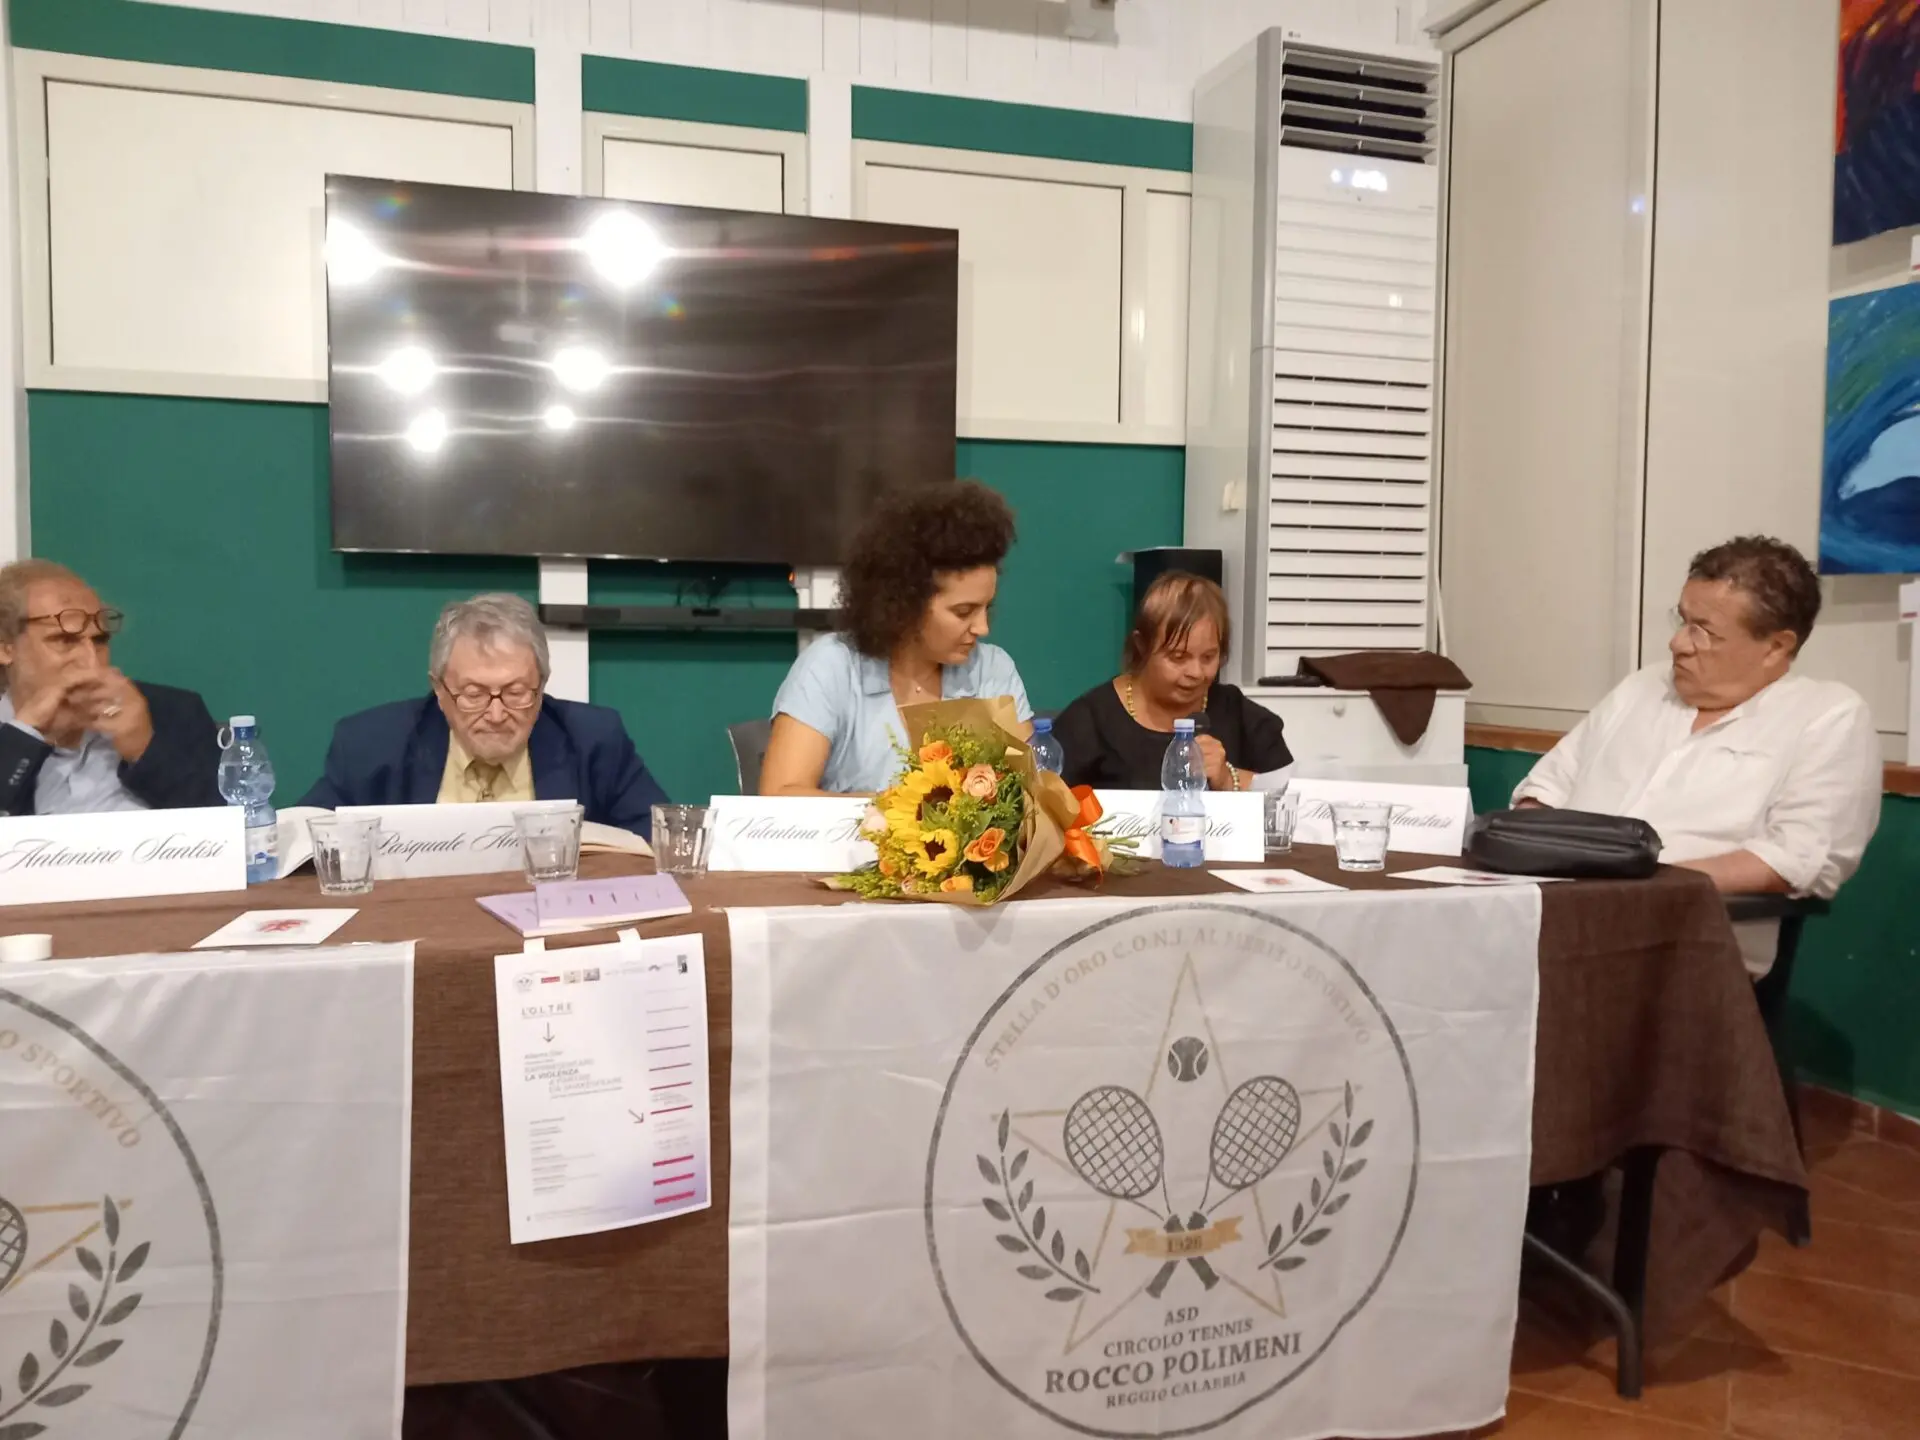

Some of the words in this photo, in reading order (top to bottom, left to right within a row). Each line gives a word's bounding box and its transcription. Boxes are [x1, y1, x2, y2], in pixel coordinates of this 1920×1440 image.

[379, 830, 466, 862] Pasquale
[726, 816, 820, 842] Valentina
[0, 838, 123, 874] Antonino
[985, 998, 1046, 1071] STELLA
[1044, 951, 1107, 999] D'ORO
[21, 1043, 141, 1148] SPORTIVO
[1164, 1306, 1199, 1326] ASD
[1103, 1331, 1184, 1358] CIRCOLO
[1188, 1318, 1254, 1343] TENNIS
[1045, 1361, 1154, 1395] ROCCO
[1162, 1332, 1303, 1380] POLIMENI
[1106, 1389, 1168, 1409] REGGIO
[1171, 1371, 1247, 1398] CALABRIA
